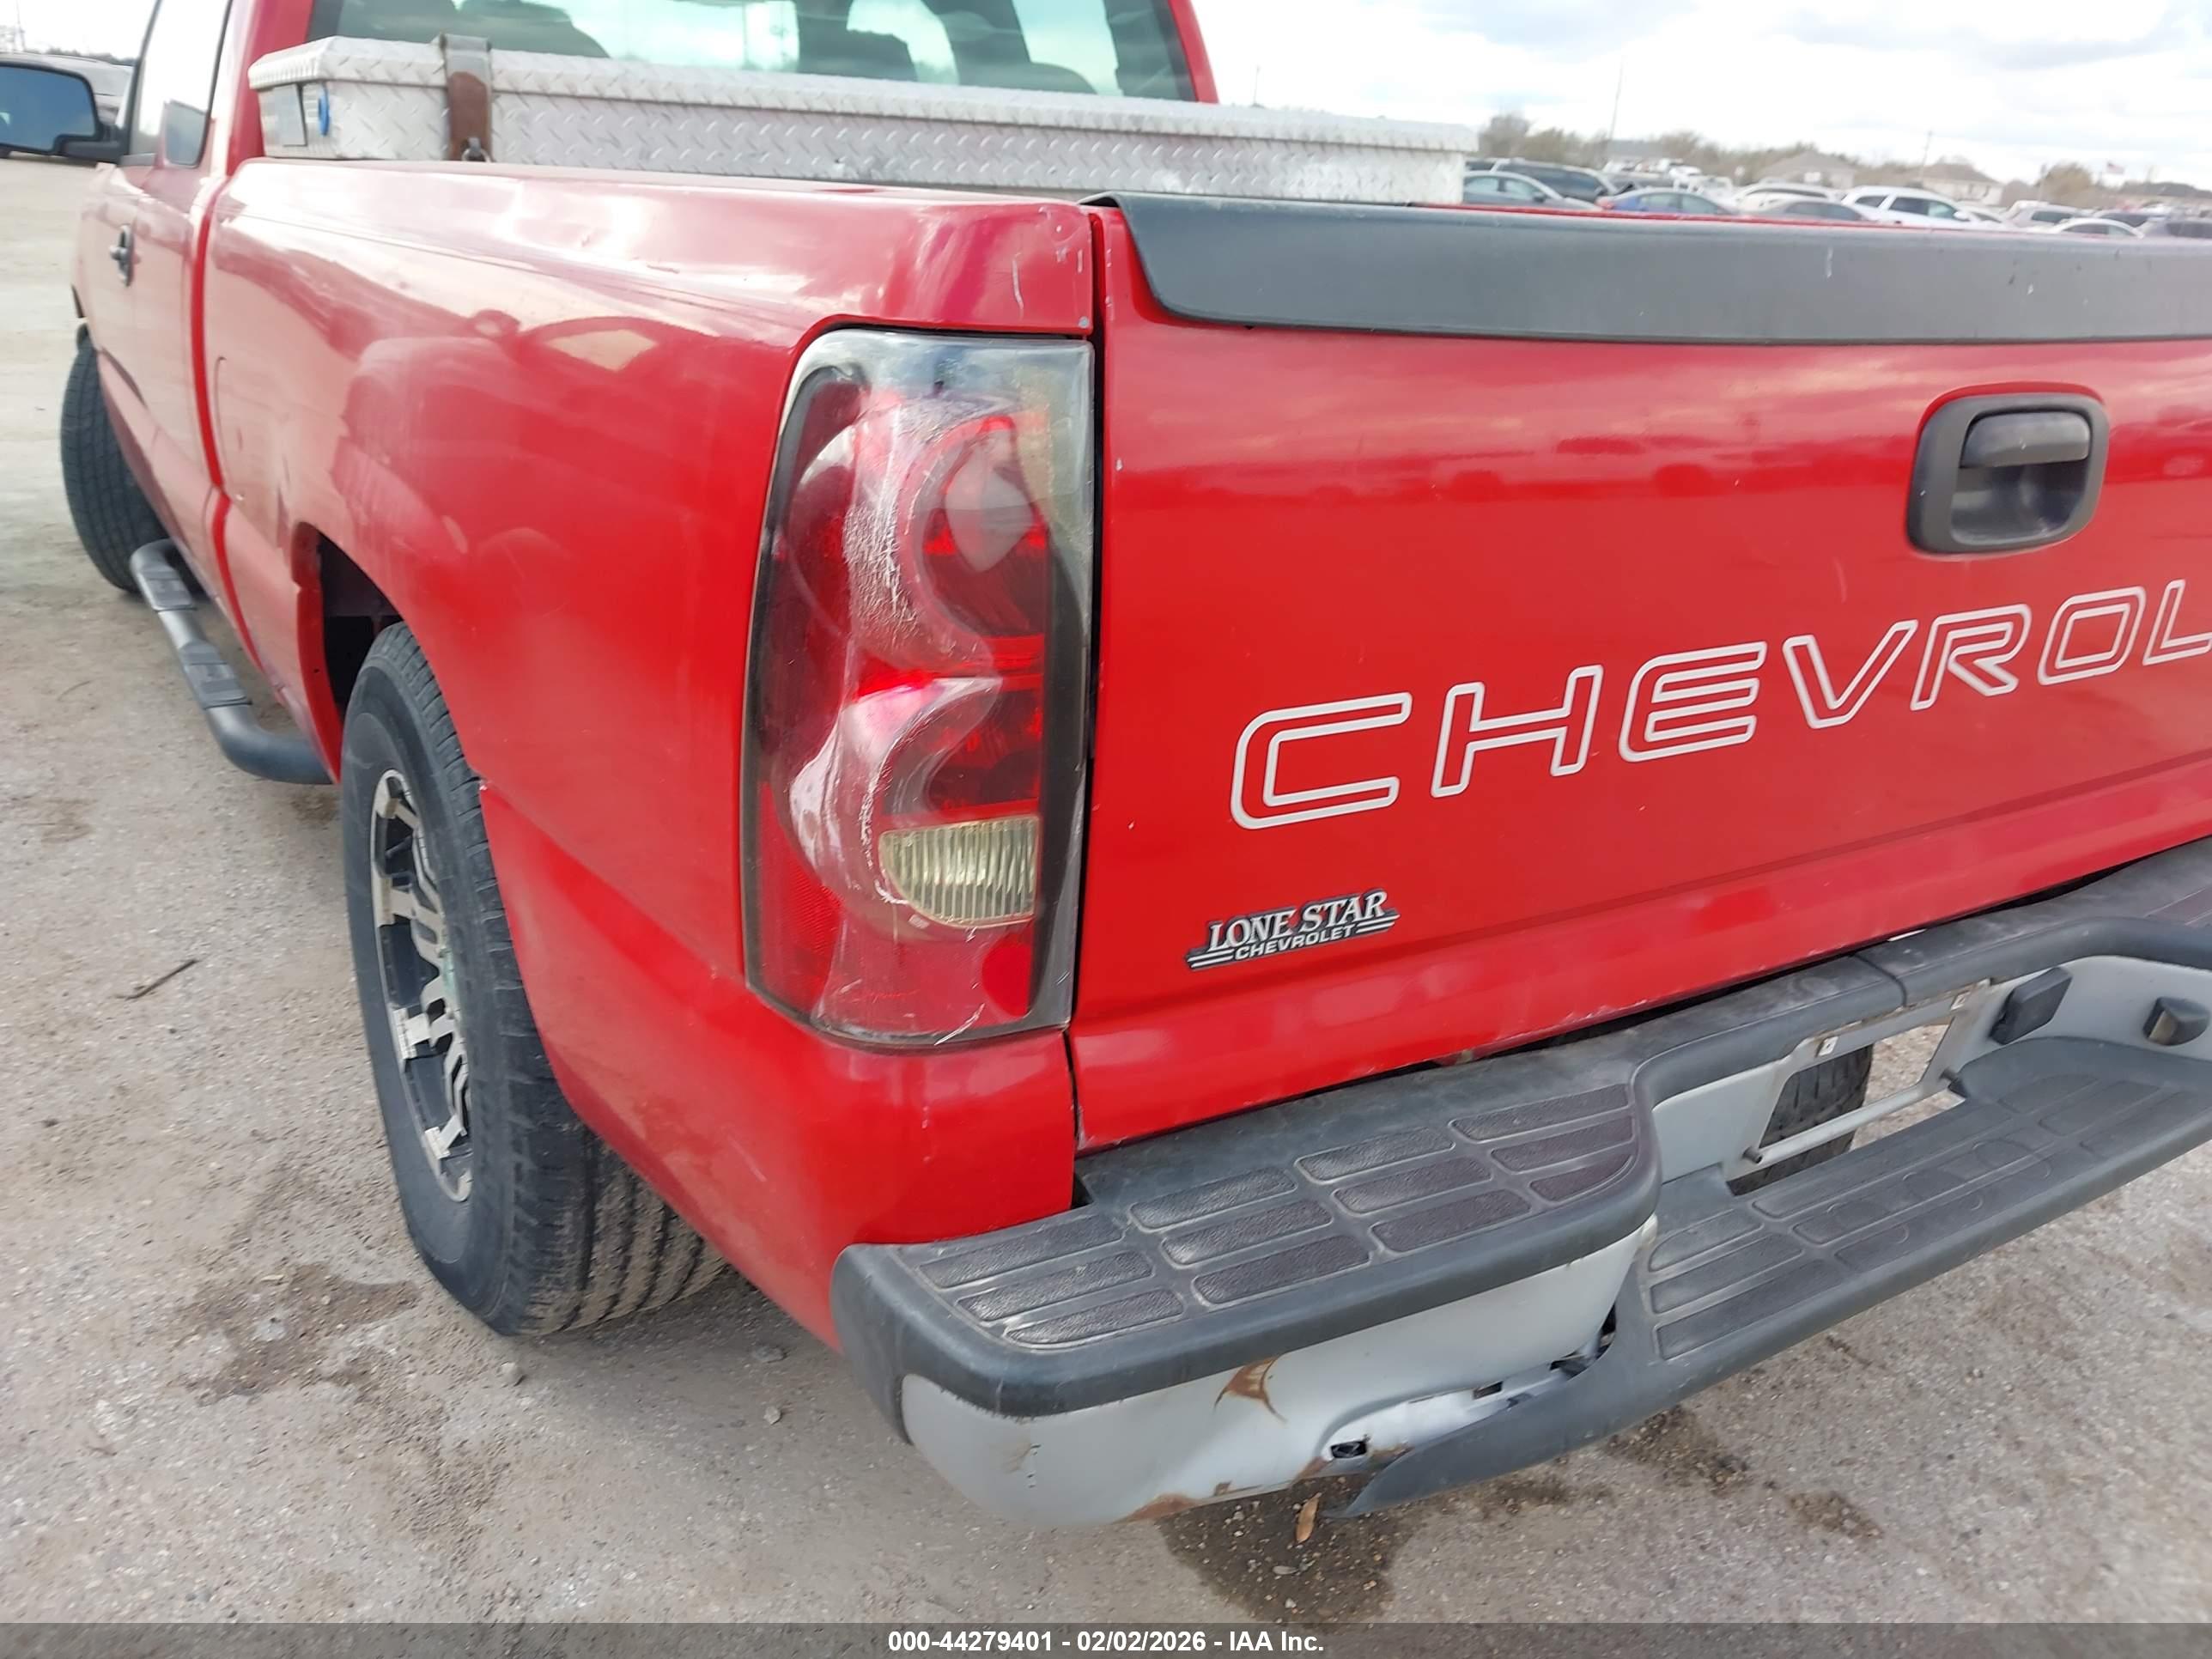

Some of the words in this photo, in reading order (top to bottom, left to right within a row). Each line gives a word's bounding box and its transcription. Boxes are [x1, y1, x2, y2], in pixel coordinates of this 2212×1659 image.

[1231, 579, 2212, 830] CHEVROL
[1208, 909, 1297, 952] LONE
[1299, 890, 1388, 933] STAR
[1234, 926, 1355, 960] CHEVROLET
